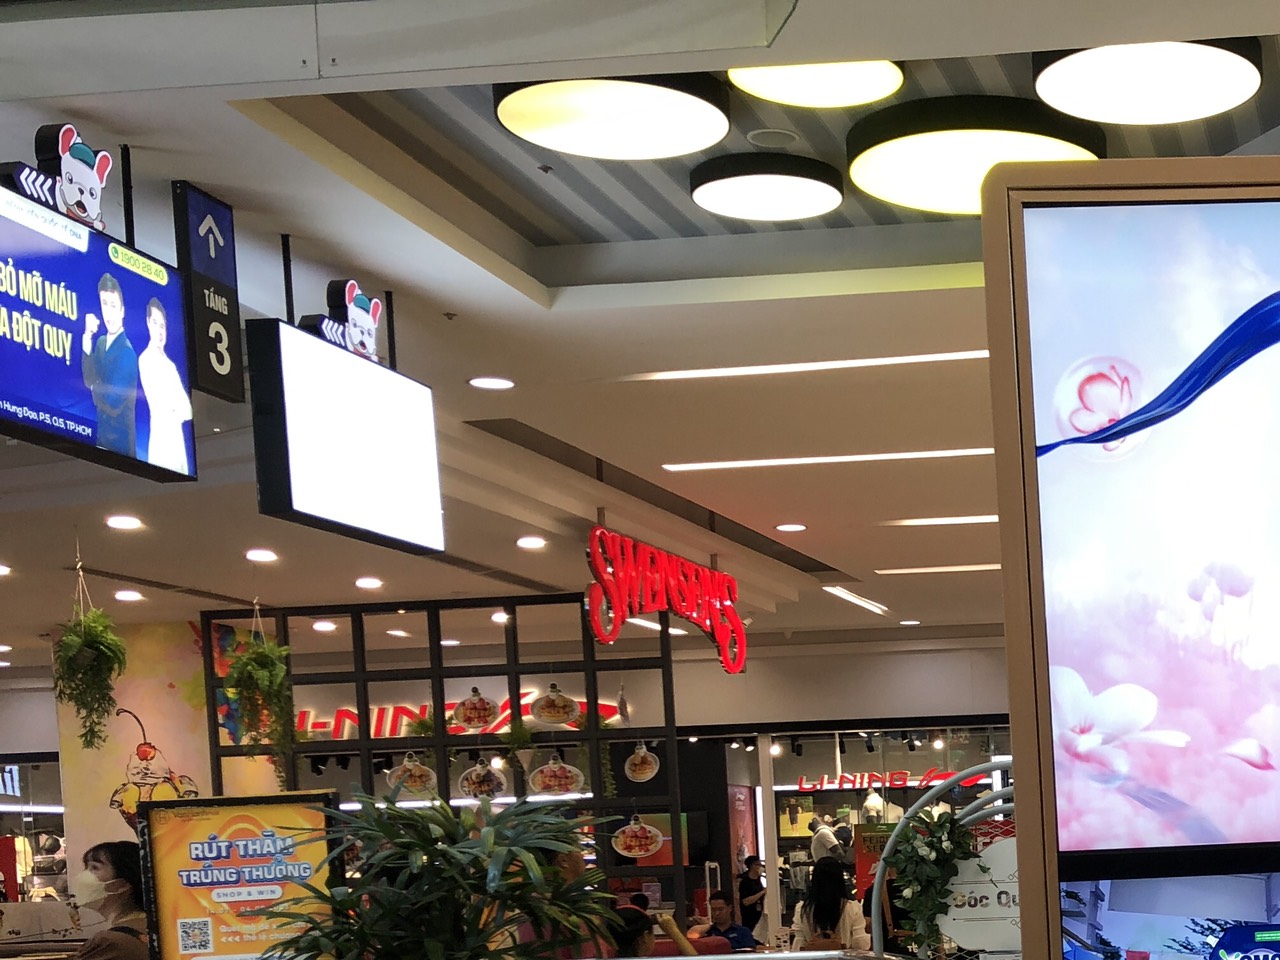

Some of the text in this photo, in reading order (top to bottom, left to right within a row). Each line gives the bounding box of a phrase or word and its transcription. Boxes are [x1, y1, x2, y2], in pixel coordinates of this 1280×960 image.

[120, 252, 141, 270] 1900
[153, 269, 164, 281] 40
[19, 270, 42, 307] MỠ
[44, 282, 77, 321] MÁU
[12, 310, 41, 351] ĐỘT
[208, 321, 231, 375] 3
[797, 770, 911, 792] LI-NING
[189, 830, 294, 860] RÚT THĂM
[179, 855, 312, 885] TRÚNG THƯỞNG
[216, 891, 243, 899] SHOP
[952, 889, 990, 909] Góc
